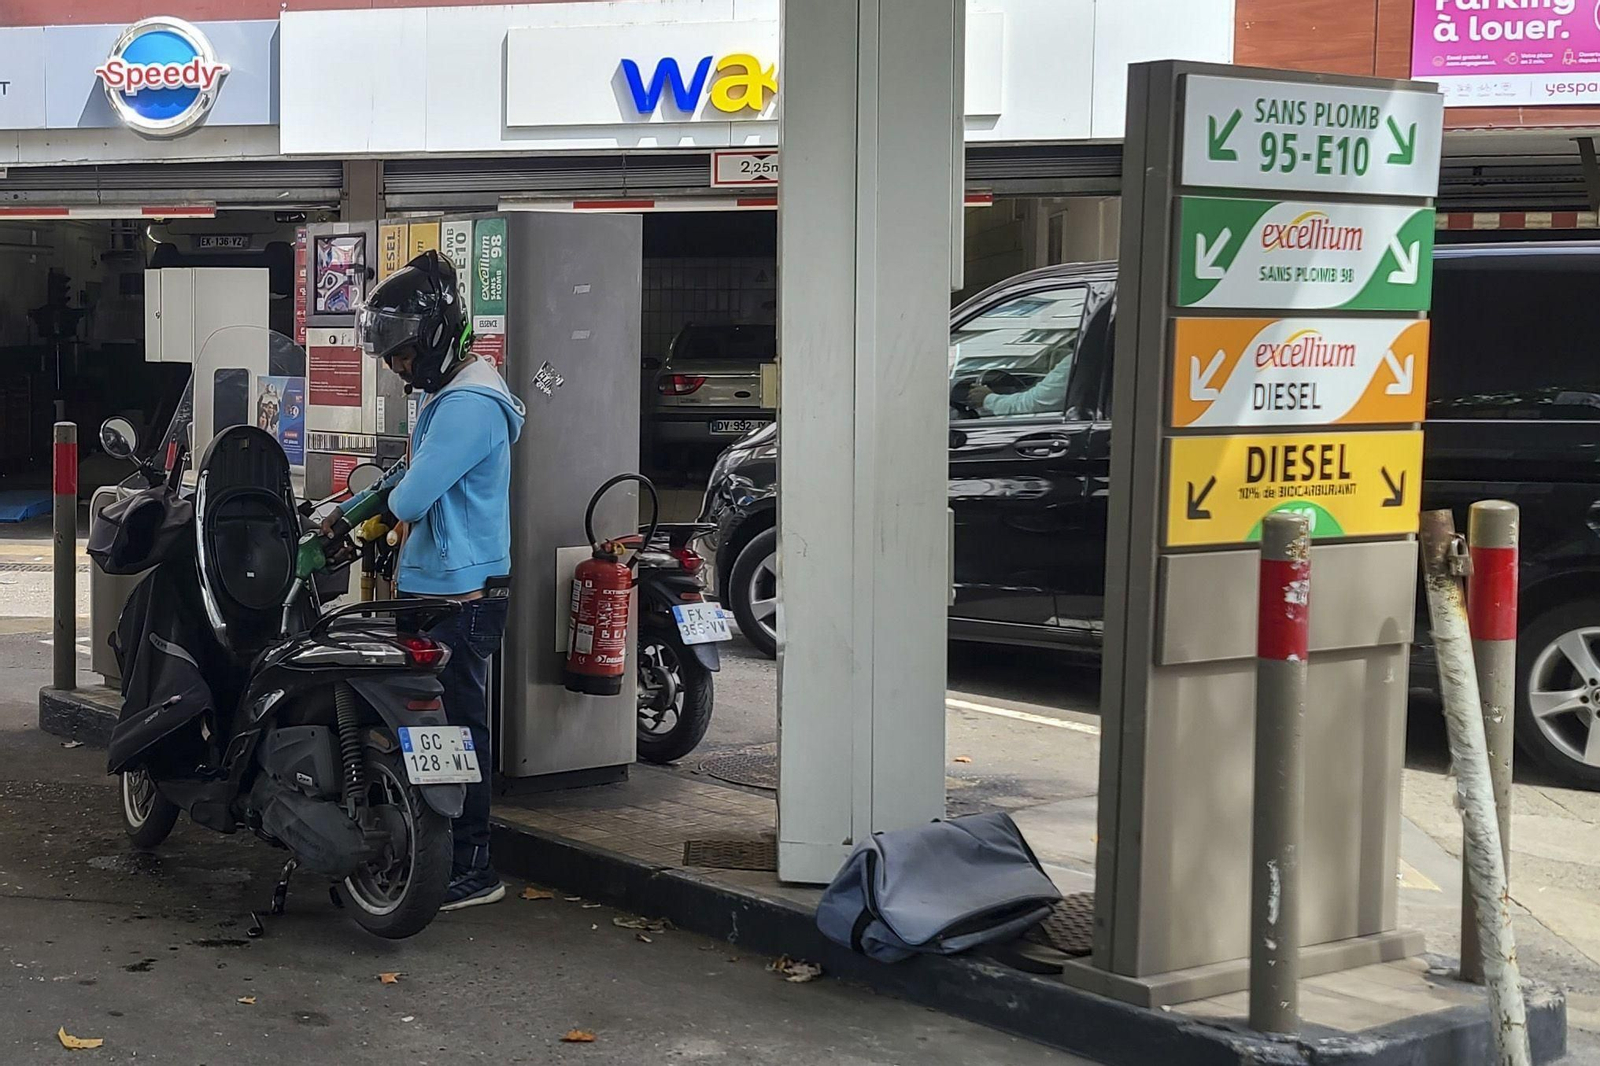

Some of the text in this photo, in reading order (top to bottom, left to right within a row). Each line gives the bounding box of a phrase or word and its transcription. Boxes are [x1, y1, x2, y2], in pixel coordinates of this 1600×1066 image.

[1433, 14, 1570, 42] à louer.
[95, 59, 223, 92] Speedy
[1255, 98, 1380, 130] SANS PLOMB
[1260, 132, 1369, 176] 95-E10
[490, 234, 502, 258] 98
[1261, 216, 1364, 251] excellium
[480, 235, 491, 301] excellium
[1258, 265, 1291, 282] SANS
[1294, 266, 1338, 282] PLOMB
[479, 319, 498, 328] ESSENCE
[1255, 335, 1356, 368] excellium
[1253, 382, 1322, 411] DIESEL
[1246, 443, 1351, 484] DIESEL
[1263, 486, 1275, 498] de
[411, 754, 475, 772] 128-WL
